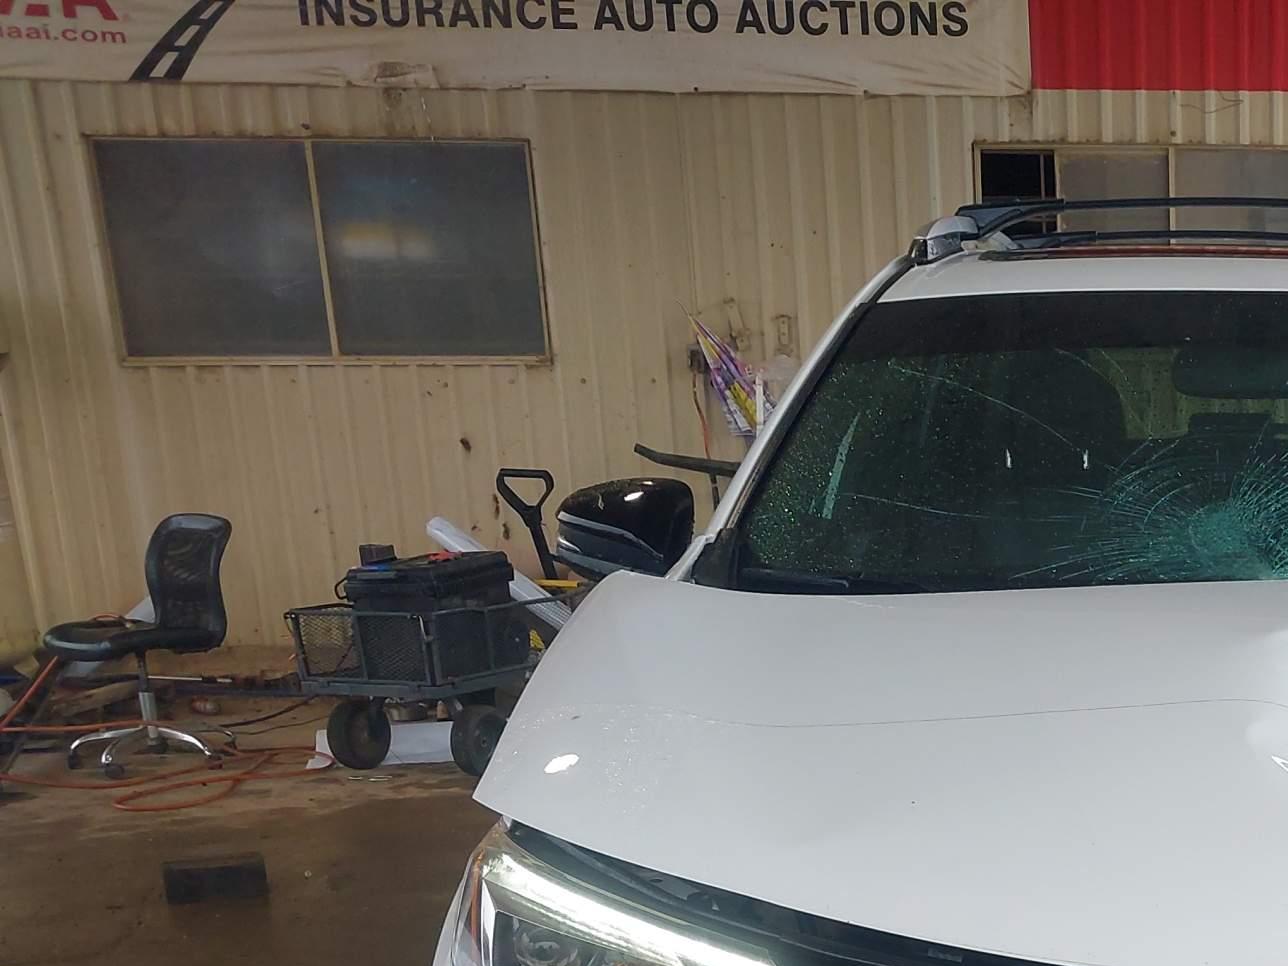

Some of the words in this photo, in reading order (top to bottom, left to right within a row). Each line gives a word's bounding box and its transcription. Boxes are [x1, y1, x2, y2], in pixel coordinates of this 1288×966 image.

[300, 0, 578, 30] INSURANCE
[594, 0, 719, 33] AUTO
[735, 0, 969, 37] AUCTIONS
